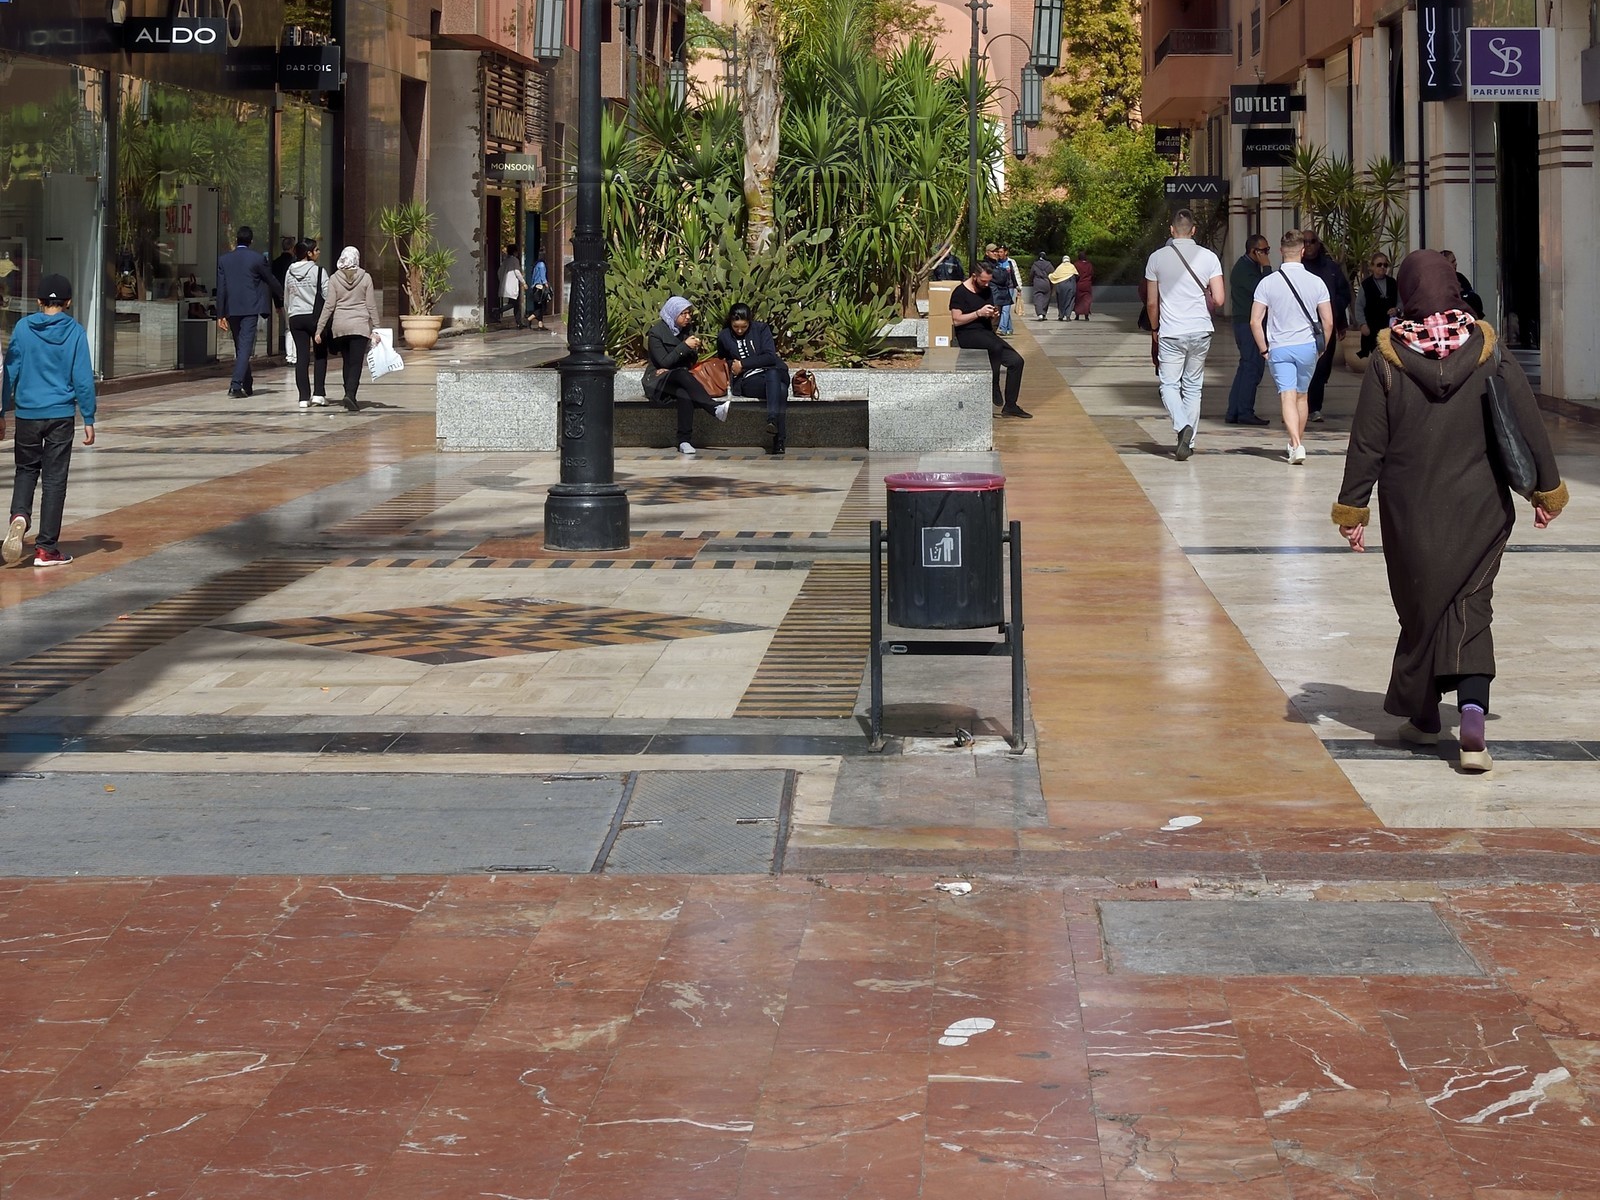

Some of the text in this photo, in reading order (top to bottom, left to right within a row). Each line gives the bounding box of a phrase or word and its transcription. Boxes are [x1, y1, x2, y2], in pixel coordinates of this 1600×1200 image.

[135, 27, 217, 44] ALDO
[1488, 37, 1522, 77] SB
[286, 64, 332, 72] PARFOIS
[1473, 88, 1540, 96] PARFUMERIE
[1234, 96, 1286, 112] OUTLET
[490, 162, 535, 171] MONSOON
[1177, 183, 1218, 193] AVVA
